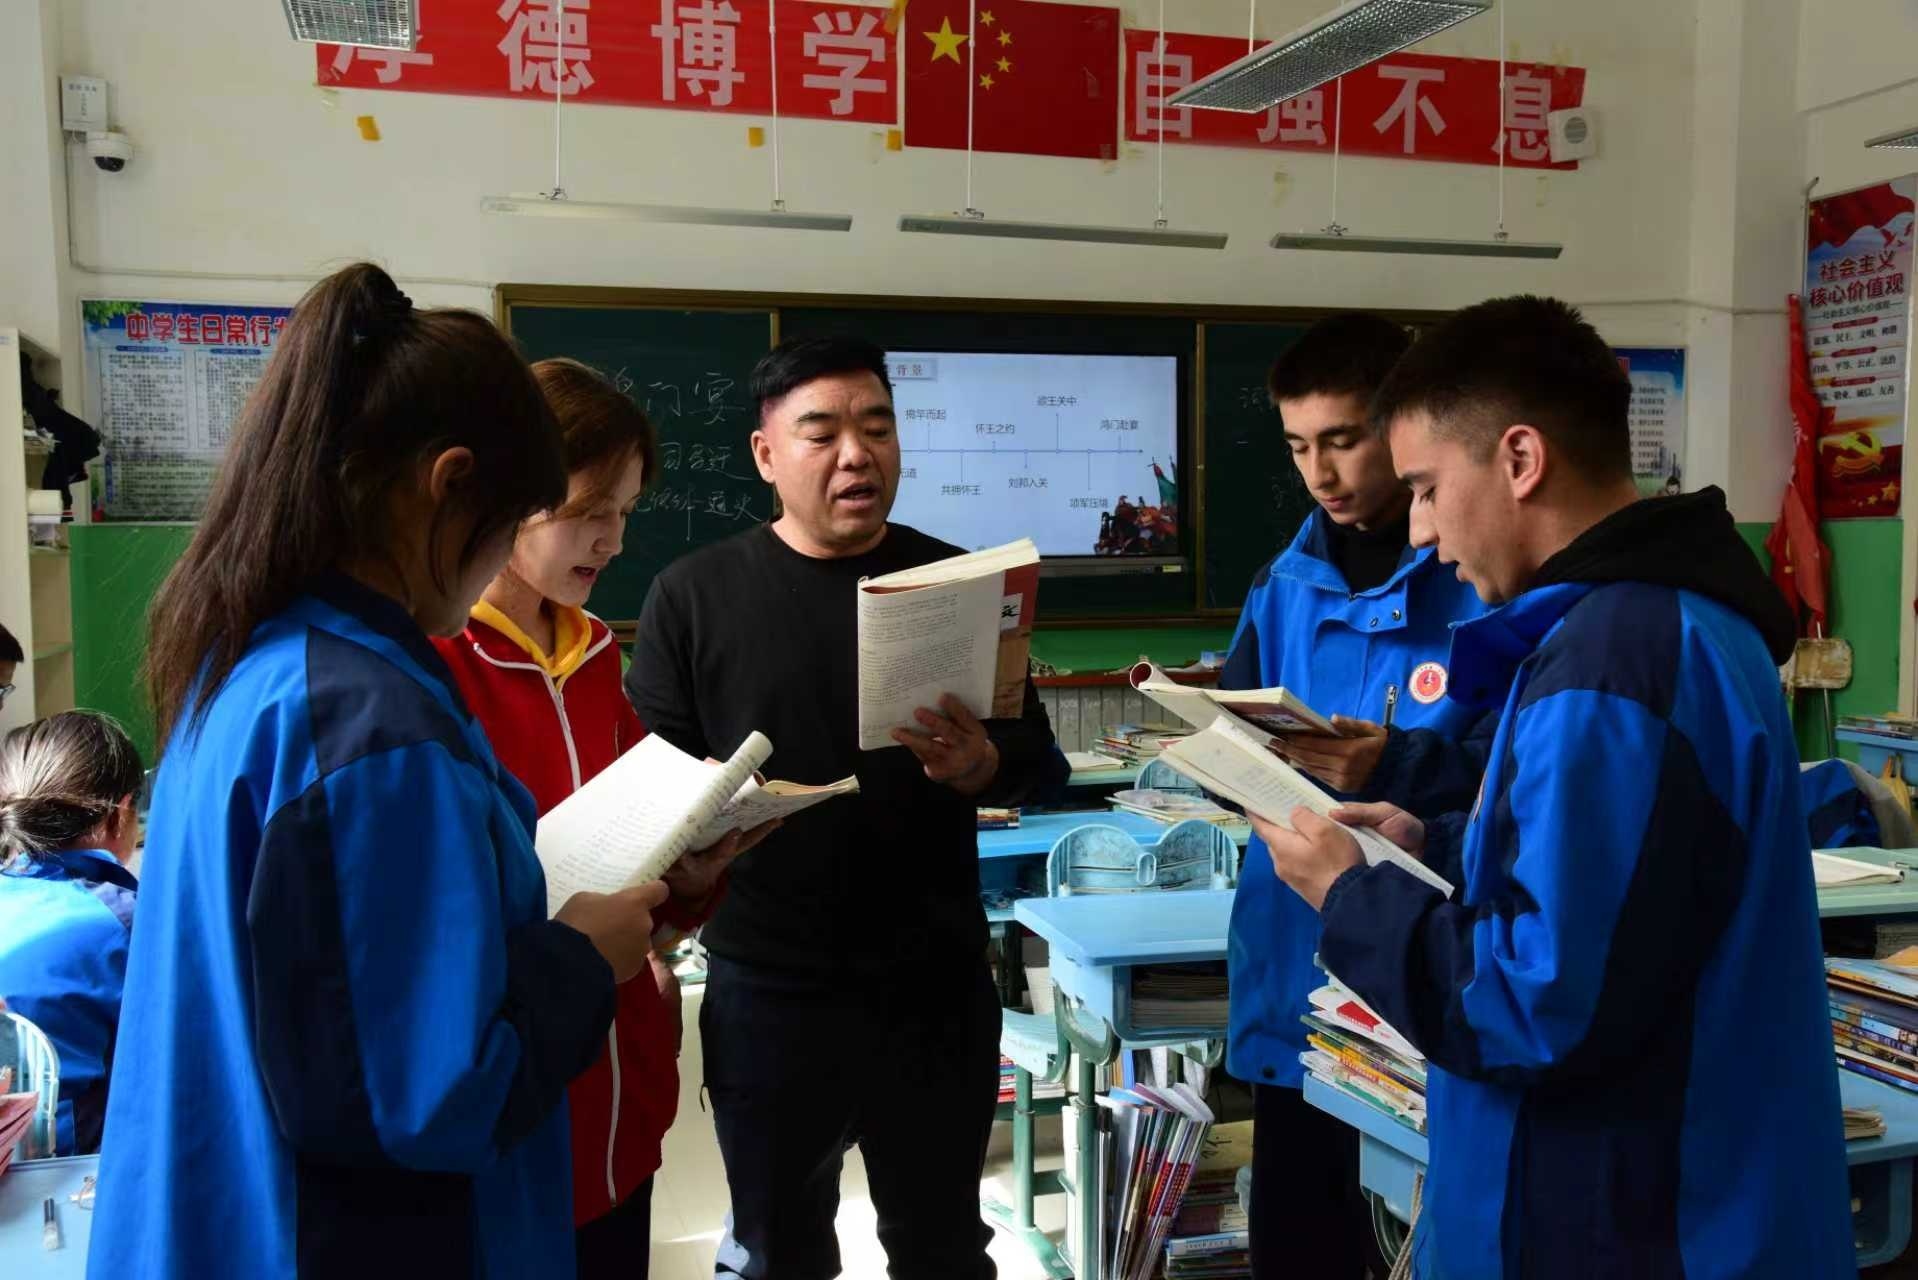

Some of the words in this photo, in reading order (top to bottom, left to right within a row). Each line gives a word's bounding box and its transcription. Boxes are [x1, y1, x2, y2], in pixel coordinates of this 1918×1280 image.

[1820, 250, 1896, 282] 社会主义
[1810, 273, 1904, 307] 核心价值观
[975, 423, 1016, 434] 怀王之约
[1008, 477, 1048, 489] 刘邦入关
[940, 484, 981, 496] 共拥怀王
